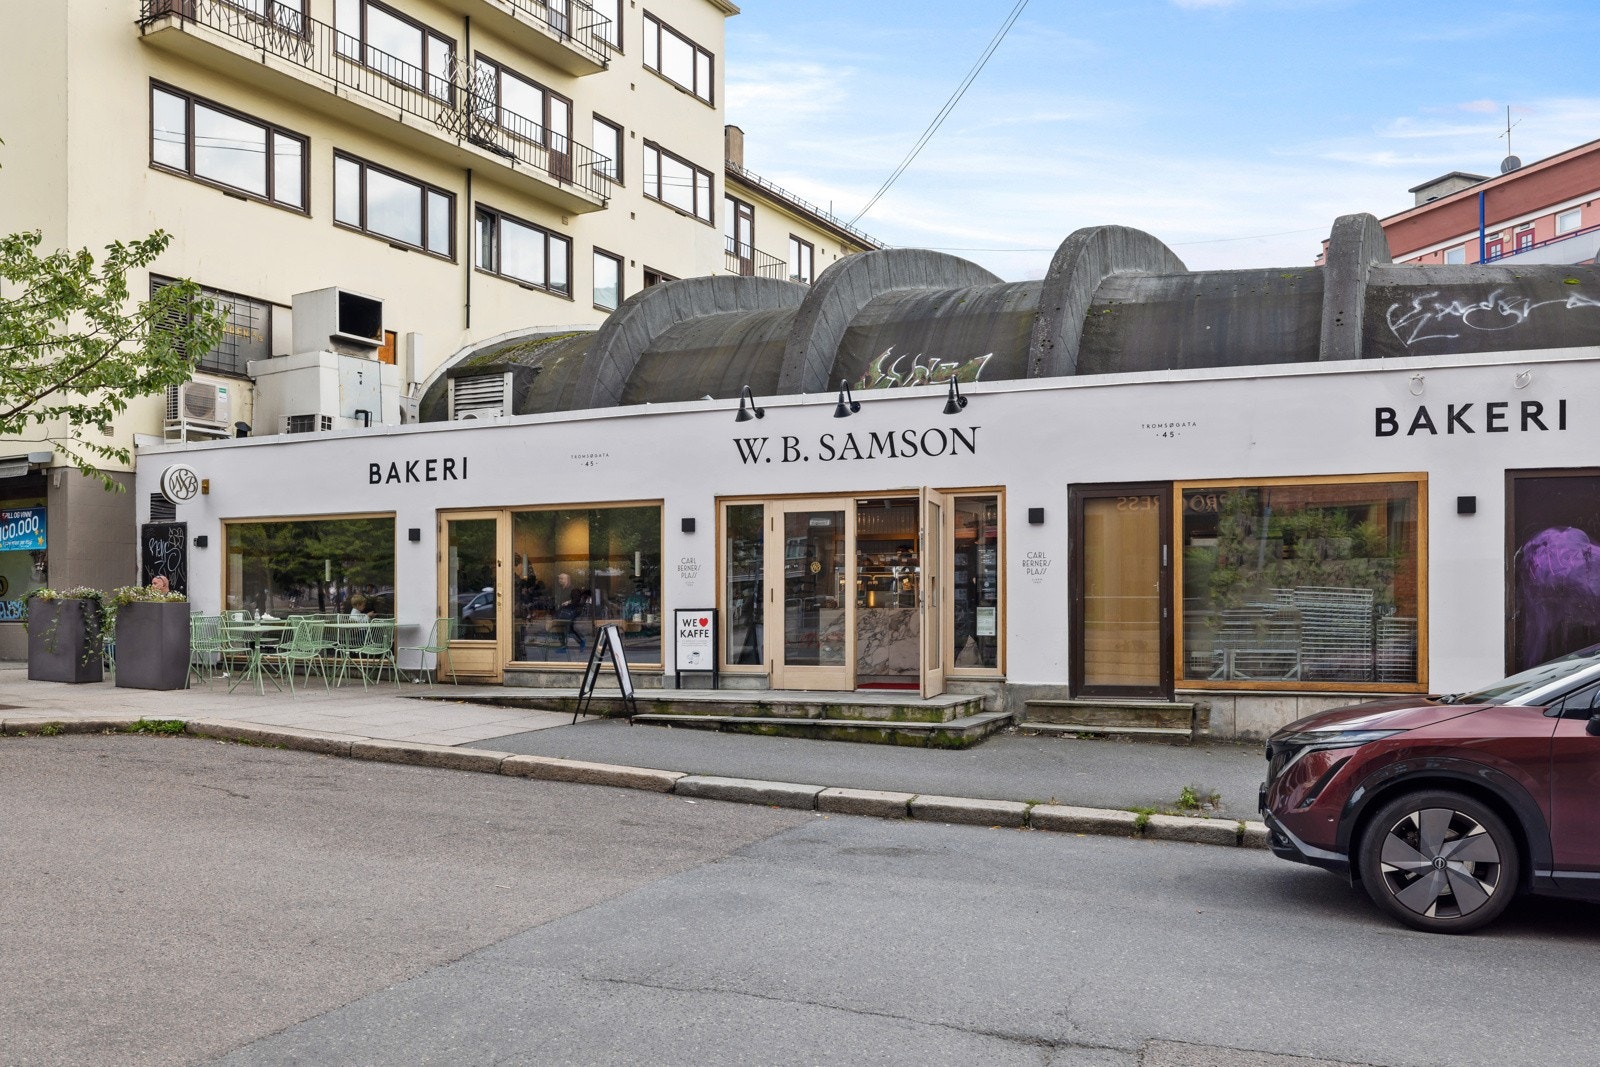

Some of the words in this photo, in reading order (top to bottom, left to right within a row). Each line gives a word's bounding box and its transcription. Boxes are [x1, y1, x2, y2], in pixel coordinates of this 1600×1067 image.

[1375, 399, 1567, 437] BAKERI
[732, 437, 771, 465] W.
[780, 435, 809, 463] B.
[818, 426, 982, 462] SAMSON
[369, 456, 468, 485] BAKERI
[680, 629, 709, 638] KAFFE
[682, 618, 697, 627] WE
